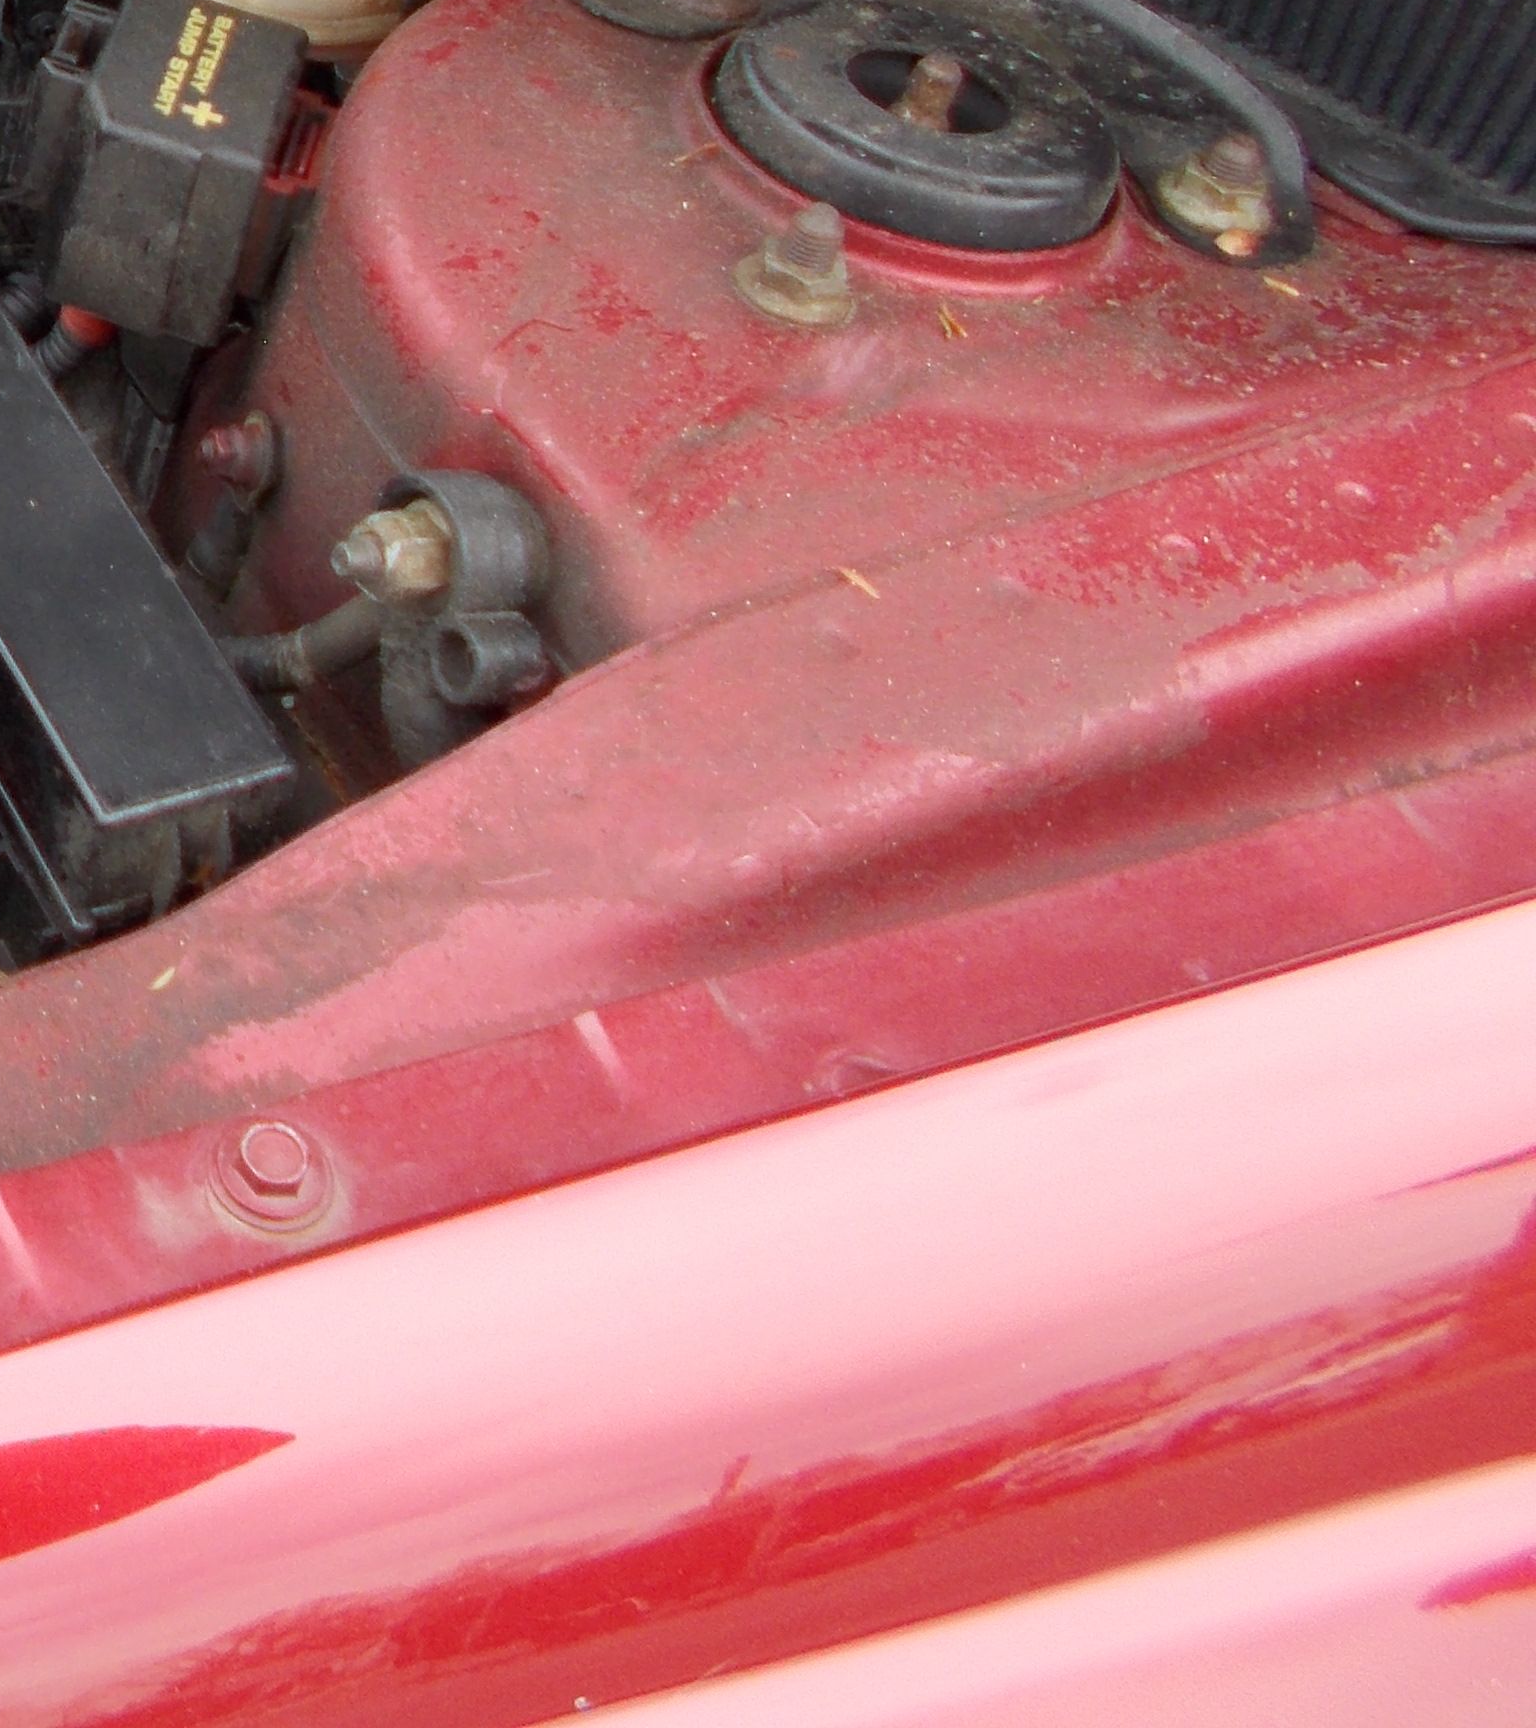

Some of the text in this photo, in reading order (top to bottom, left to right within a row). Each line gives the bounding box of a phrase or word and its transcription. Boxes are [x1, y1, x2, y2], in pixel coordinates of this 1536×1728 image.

[153, 7, 208, 116] JUMP START
[189, 15, 234, 94] BATTERY
